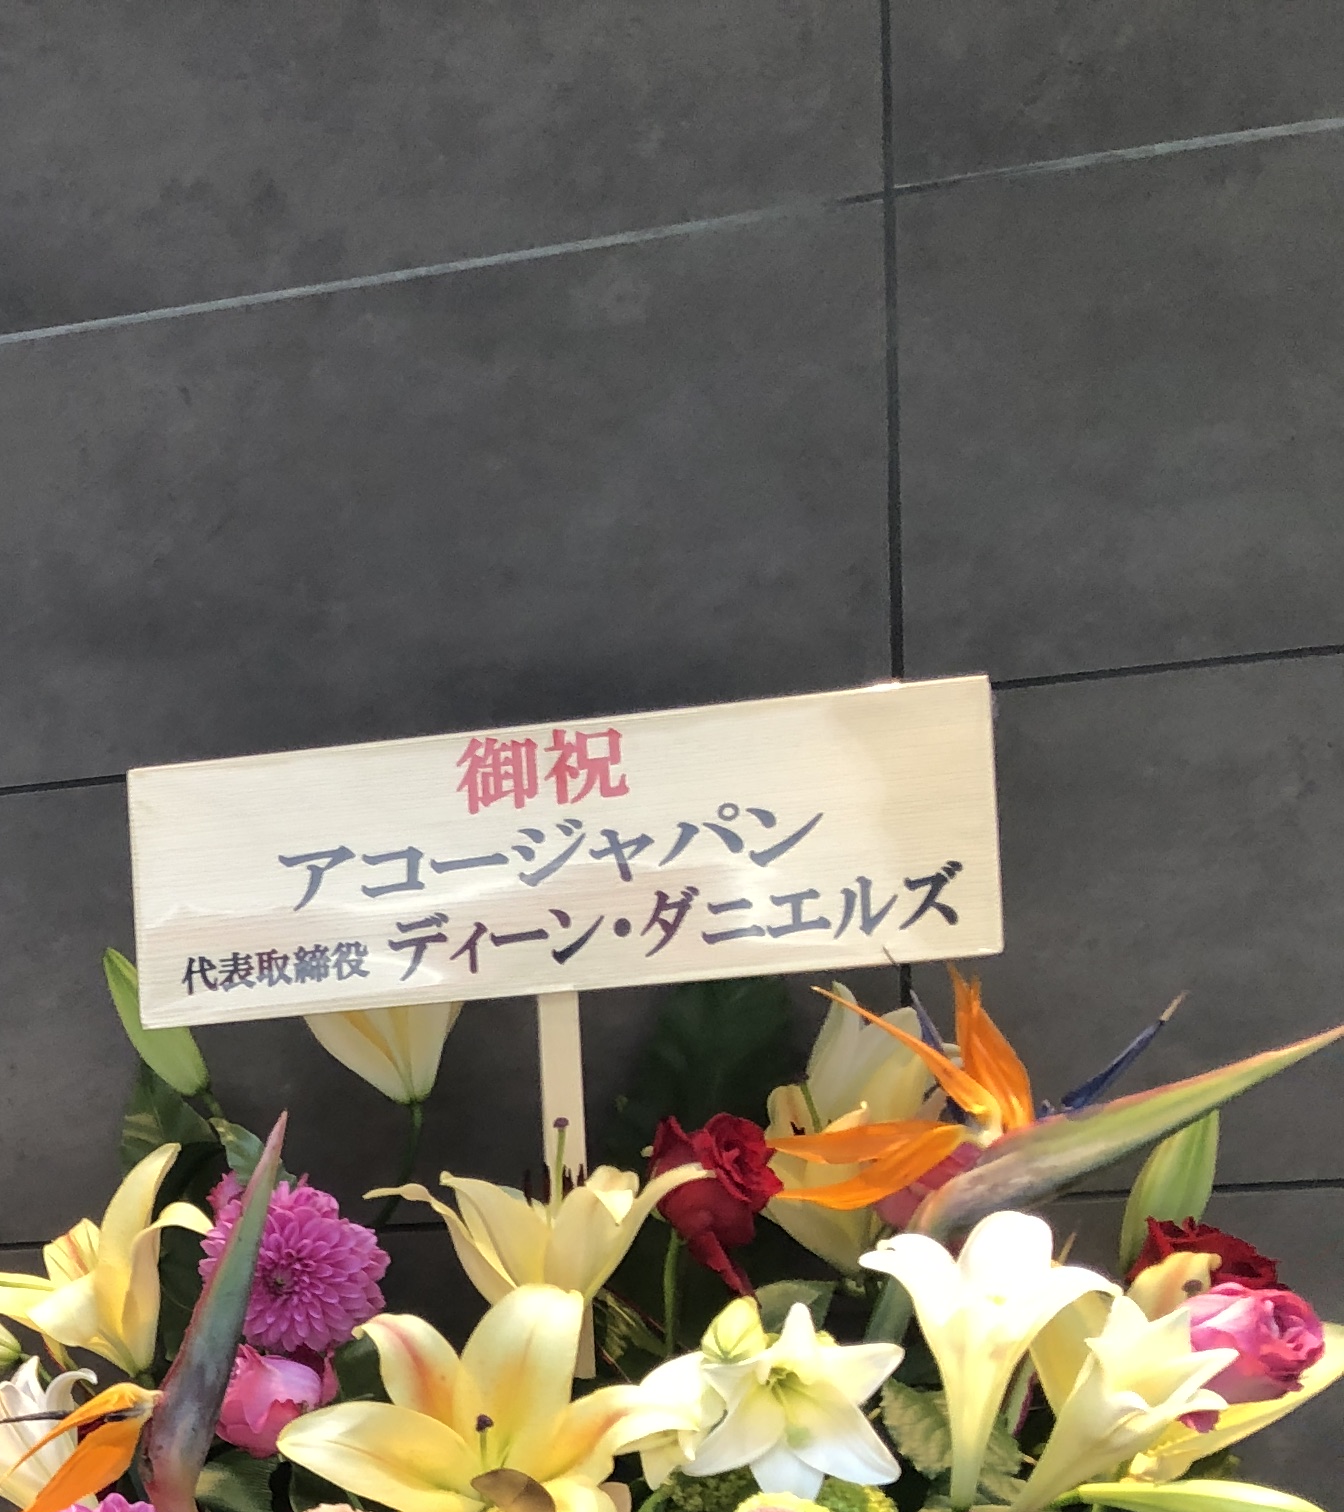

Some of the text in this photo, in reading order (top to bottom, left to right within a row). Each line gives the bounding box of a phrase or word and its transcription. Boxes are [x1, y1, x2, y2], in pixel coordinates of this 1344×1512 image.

[457, 727, 630, 814] 御祝
[278, 802, 824, 912] アコージャパン
[181, 860, 965, 994] 代表取締役 ディーン・ダニエルズ
